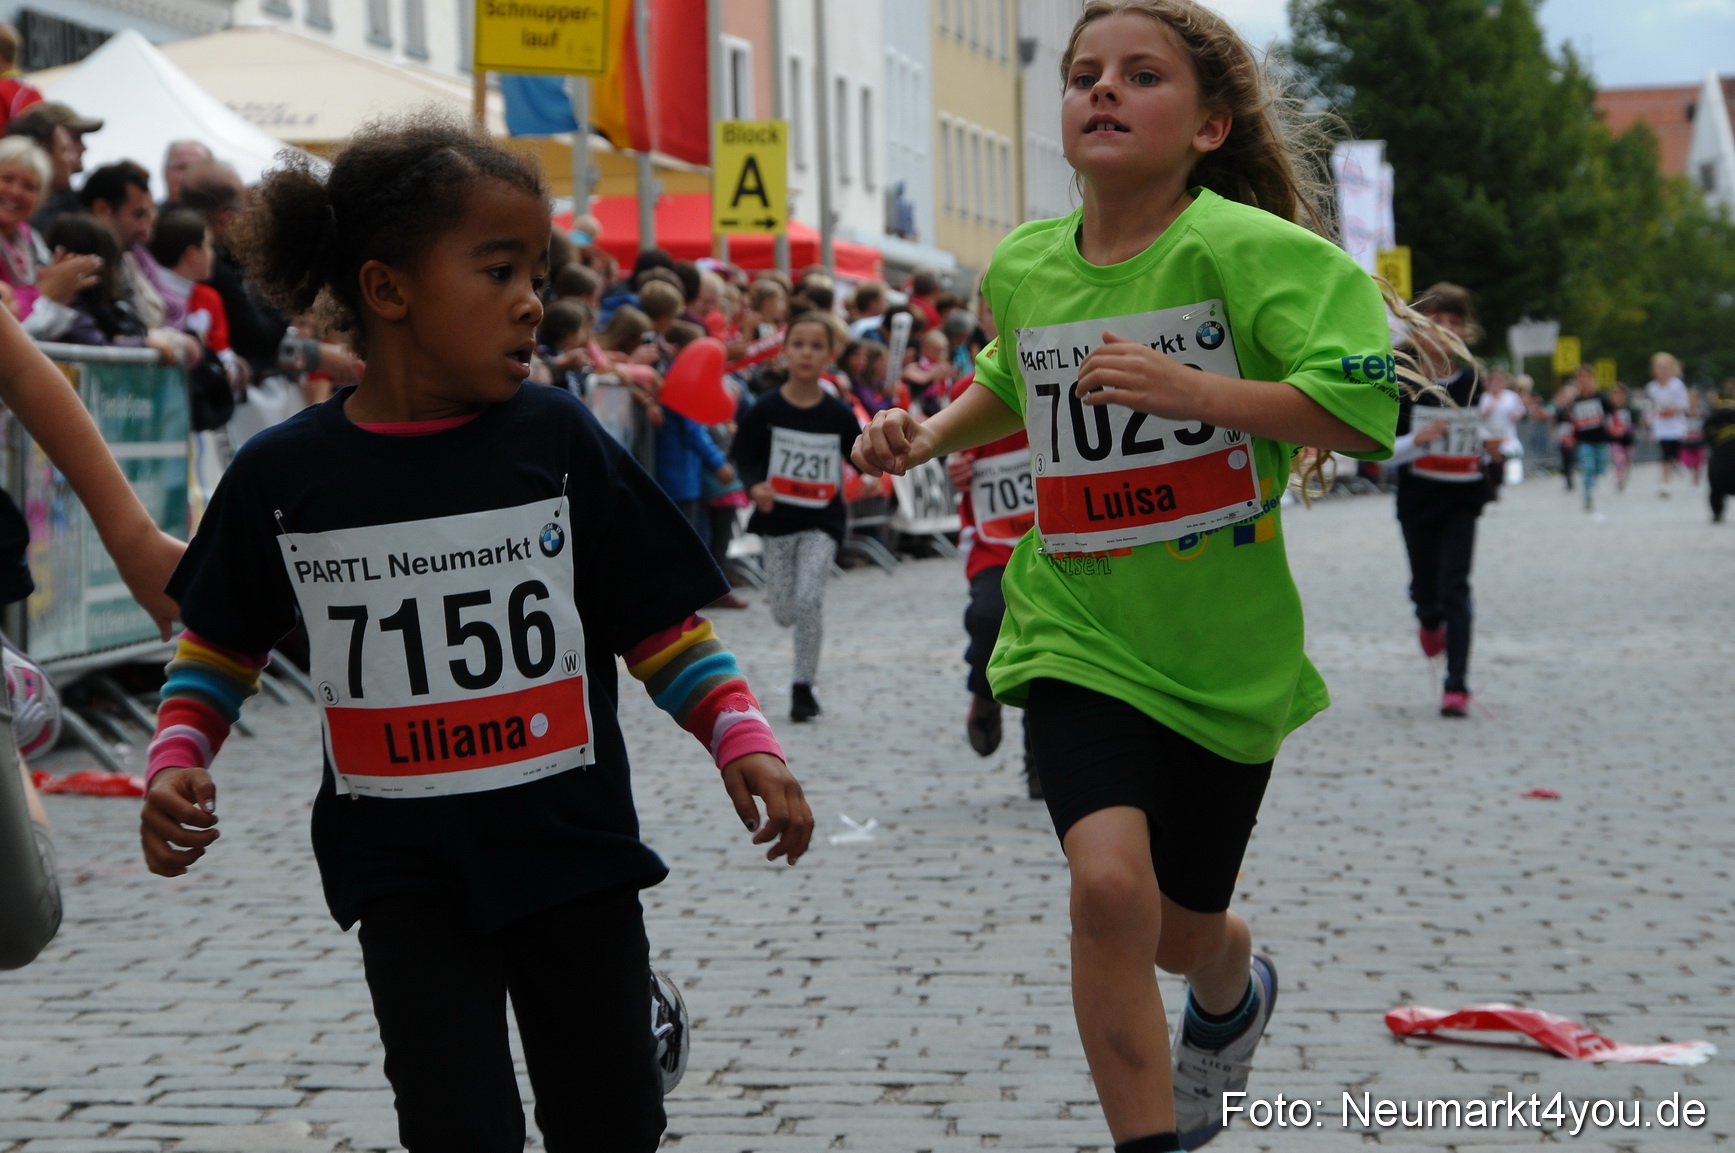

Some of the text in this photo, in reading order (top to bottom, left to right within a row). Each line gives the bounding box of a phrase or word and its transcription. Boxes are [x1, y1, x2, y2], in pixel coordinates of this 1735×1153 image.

[486, 0, 598, 23] Schnupper-
[521, 26, 559, 47] lauf
[723, 123, 778, 143] Block
[730, 154, 769, 209] A
[1226, 430, 1241, 443] W
[780, 448, 830, 480] 7231
[1084, 482, 1177, 522] Luisa
[294, 537, 532, 583] PARTL Neumarkt
[327, 579, 557, 699] 7156
[384, 716, 527, 764] Liliana
